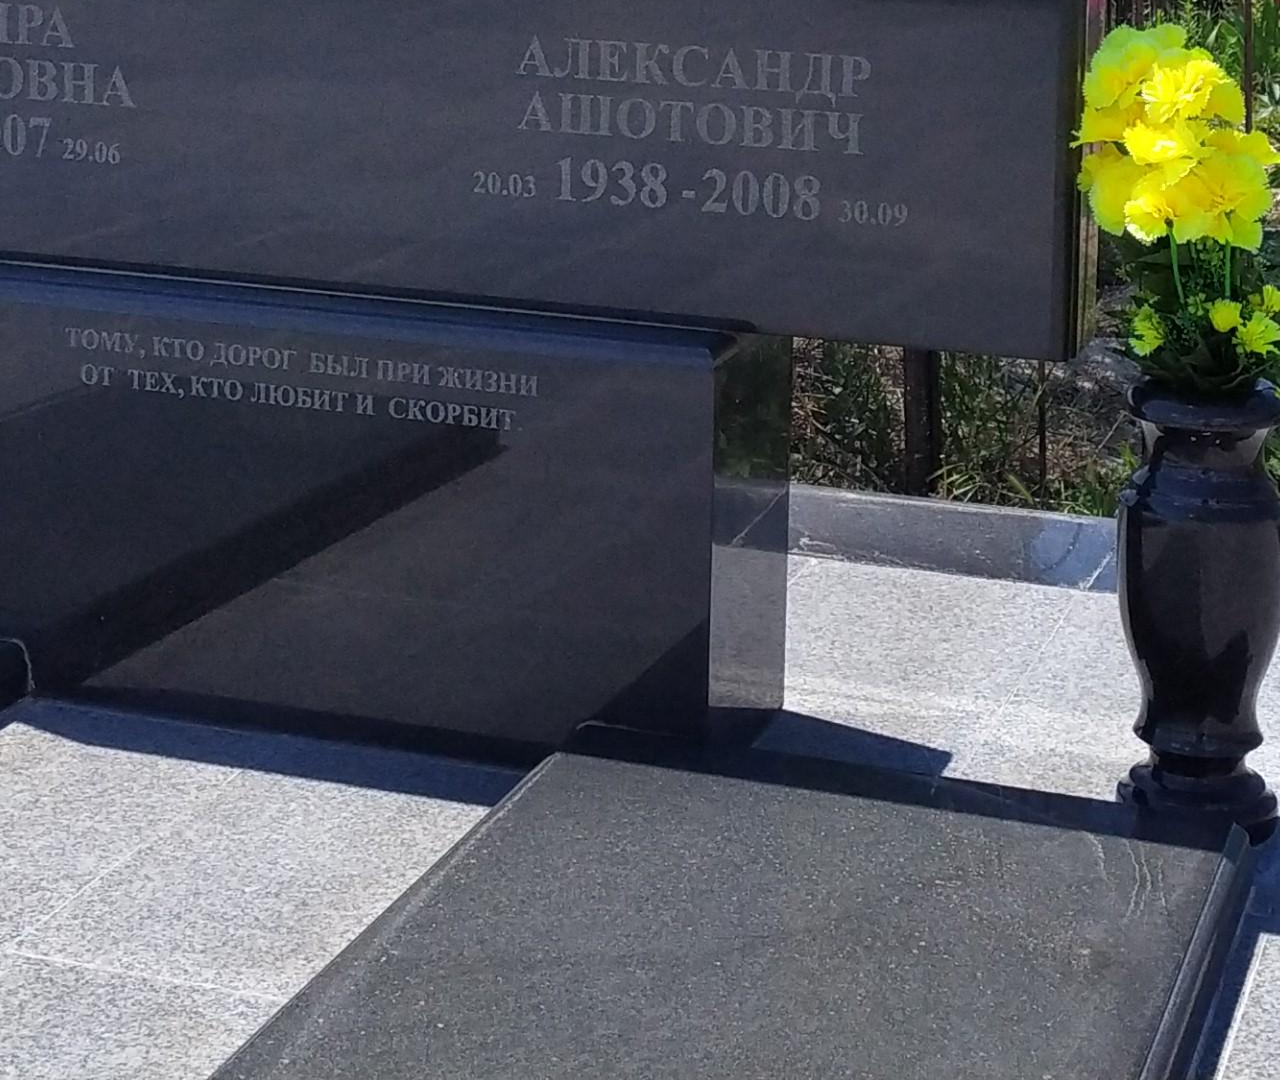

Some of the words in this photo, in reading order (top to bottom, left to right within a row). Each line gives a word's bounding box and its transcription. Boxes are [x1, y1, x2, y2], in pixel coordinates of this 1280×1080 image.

[516, 34, 872, 106] АЛЕКСАНДР
[61, 137, 121, 165] 29.06
[518, 91, 864, 156] АШОТОВИЧ
[472, 170, 537, 199] 20.03
[839, 199, 909, 227] 30.09
[79, 362, 114, 386] ОТ
[189, 375, 243, 402] КТО
[250, 382, 349, 412] ЛЮБИТ
[354, 393, 376, 417] И
[152, 336, 205, 362] КТО
[209, 341, 298, 370] ДОРОГ
[308, 352, 369, 380] БЫЛ
[376, 359, 430, 386] ПРИ
[437, 366, 540, 397] ЖИЗНИ
